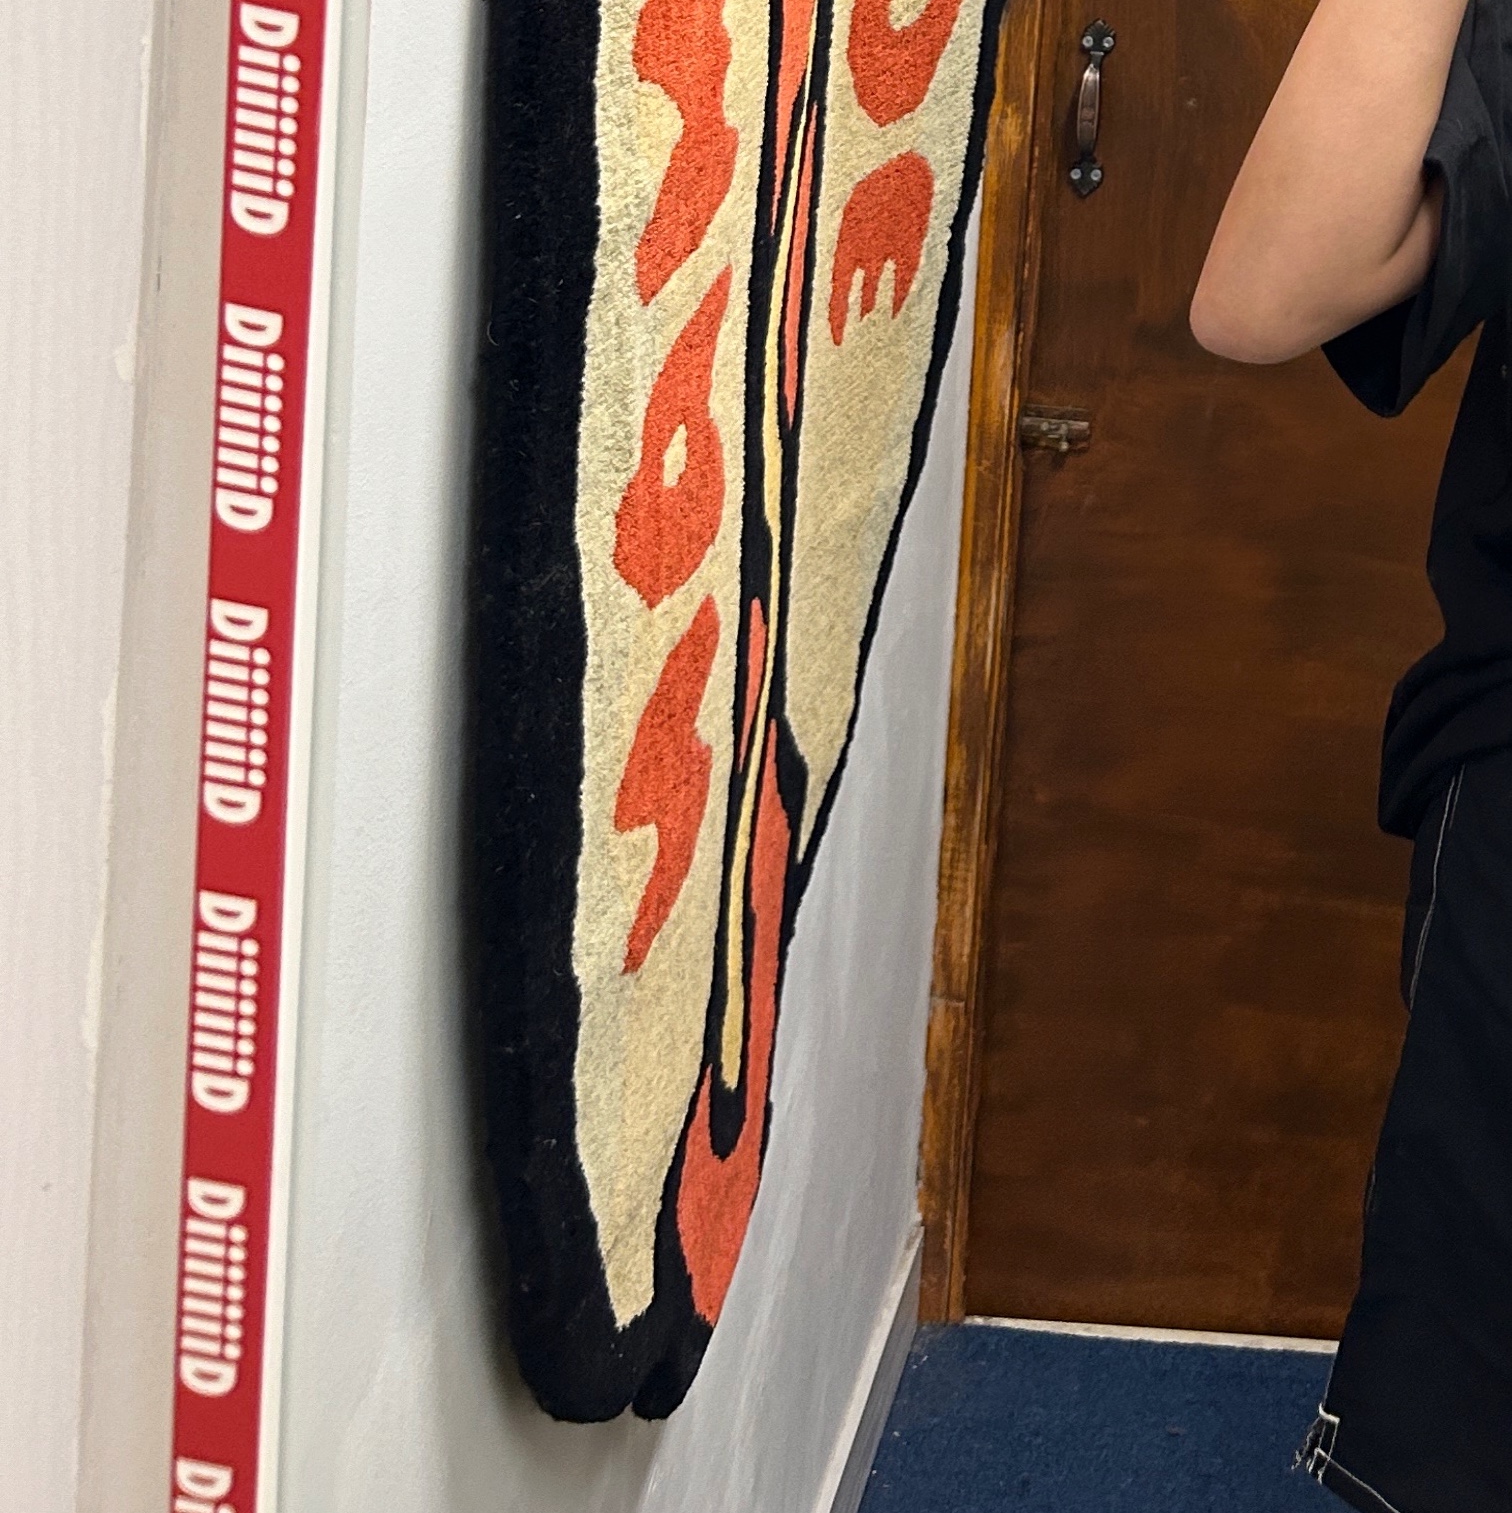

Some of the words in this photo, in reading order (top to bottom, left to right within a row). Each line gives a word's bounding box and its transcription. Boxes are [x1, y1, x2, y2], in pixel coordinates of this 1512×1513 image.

[230, 3, 301, 235] DiiiiiiiD
[215, 303, 285, 532] DiiiiiiiD
[203, 598, 271, 824] DiiiiiiiD
[191, 891, 259, 1113] DiiiiiiiD
[180, 1179, 246, 1396] DiiiiiiiD
